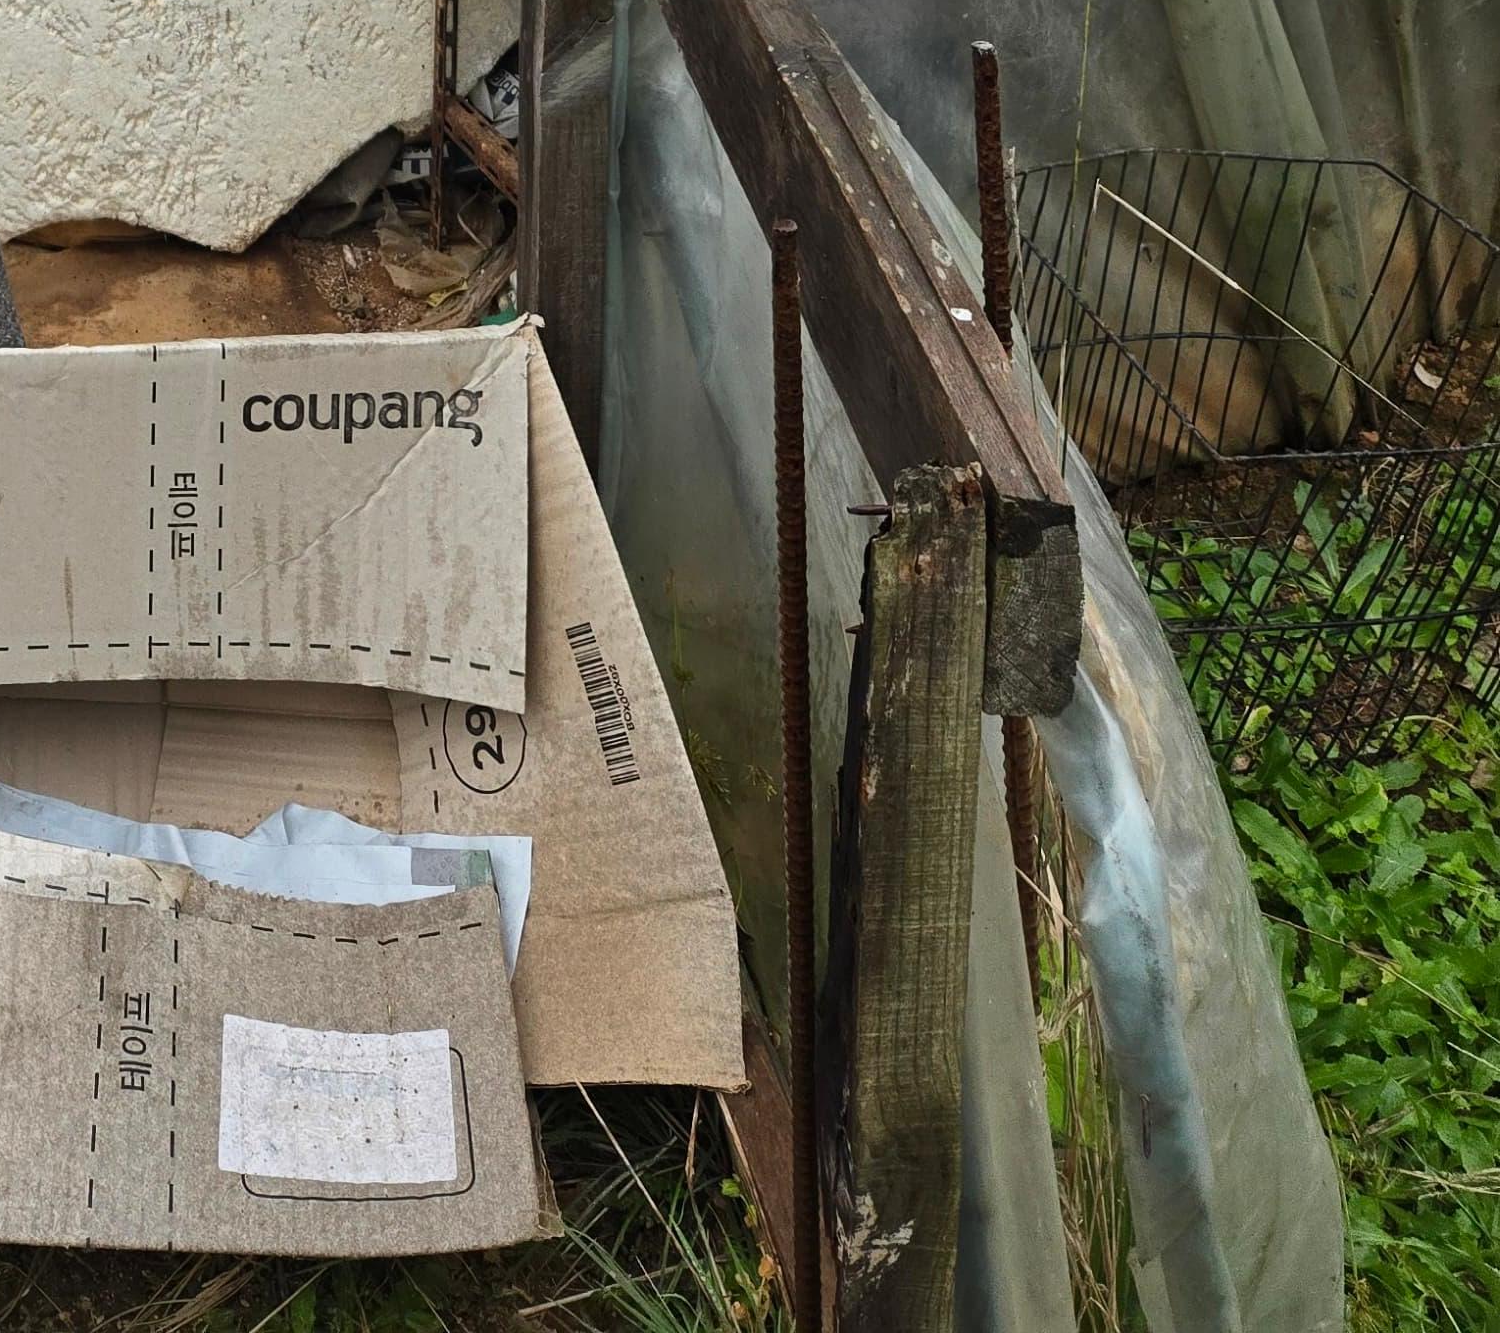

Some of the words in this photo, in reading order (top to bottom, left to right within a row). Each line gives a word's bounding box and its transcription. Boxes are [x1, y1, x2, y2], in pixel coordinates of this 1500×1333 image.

[242, 387, 484, 448] coupang
[167, 472, 198, 560] 테이프
[607, 664, 635, 731] BOX00X92
[464, 704, 505, 770] 29
[118, 992, 153, 1091] 테이프
